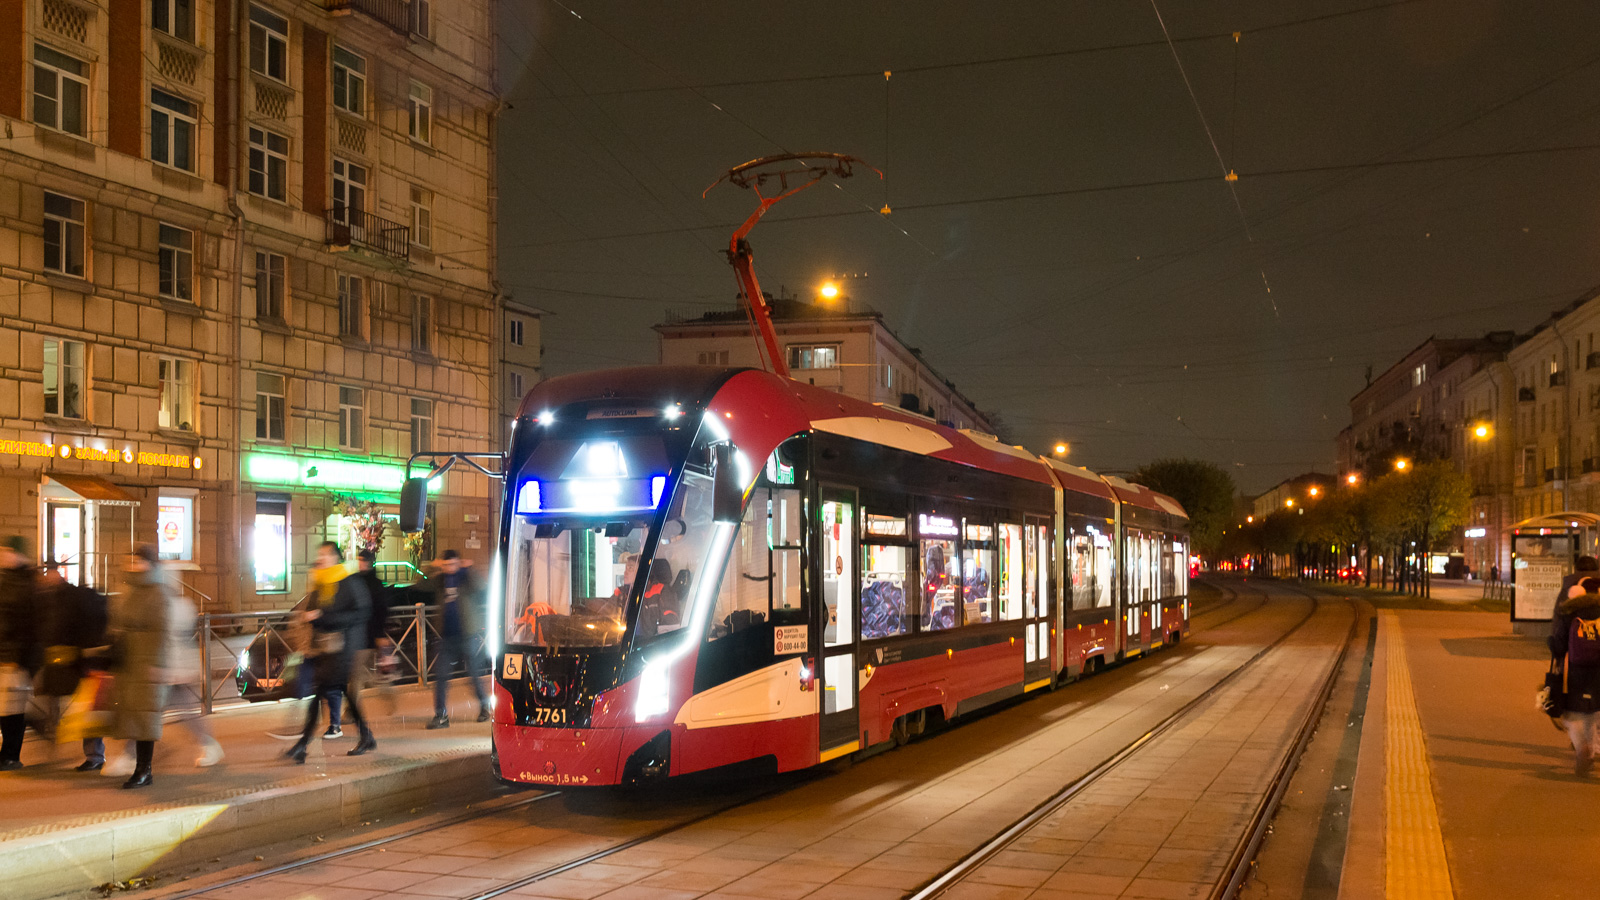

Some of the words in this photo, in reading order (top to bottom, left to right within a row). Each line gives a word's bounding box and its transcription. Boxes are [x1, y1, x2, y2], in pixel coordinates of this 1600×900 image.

[137, 452, 190, 468] ЛОМБАРД
[784, 641, 806, 651] 600-44-00
[535, 708, 566, 724] 7761
[526, 771, 554, 782] Вынос
[557, 773, 570, 784] 1,5
